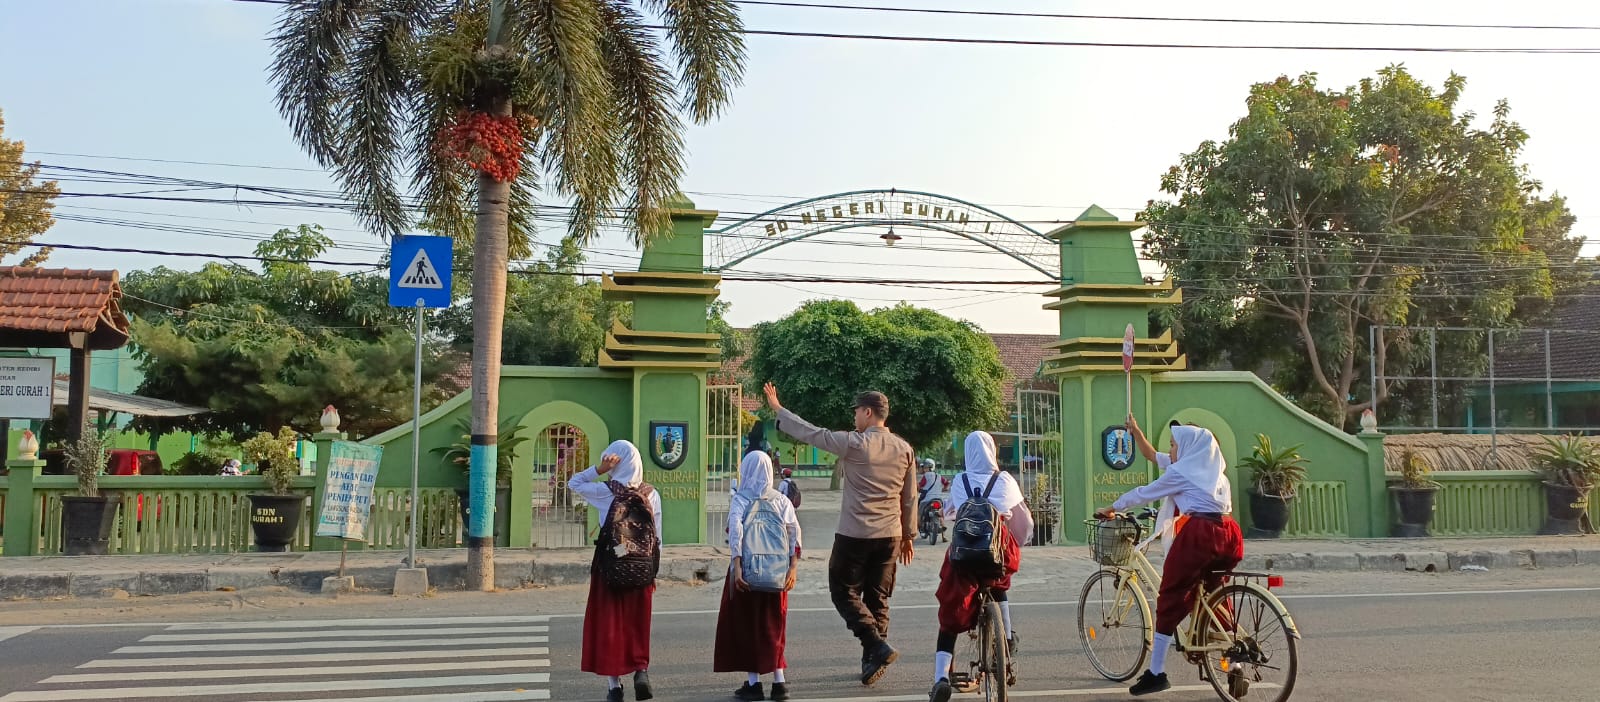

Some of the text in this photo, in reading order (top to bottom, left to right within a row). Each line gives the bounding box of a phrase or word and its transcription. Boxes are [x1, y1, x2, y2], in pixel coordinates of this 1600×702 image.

[765, 219, 789, 236] SD
[801, 200, 884, 225] NEGERI
[903, 201, 970, 225] GURAH
[16, 386, 42, 396] GURAH
[46, 386, 49, 396] 1
